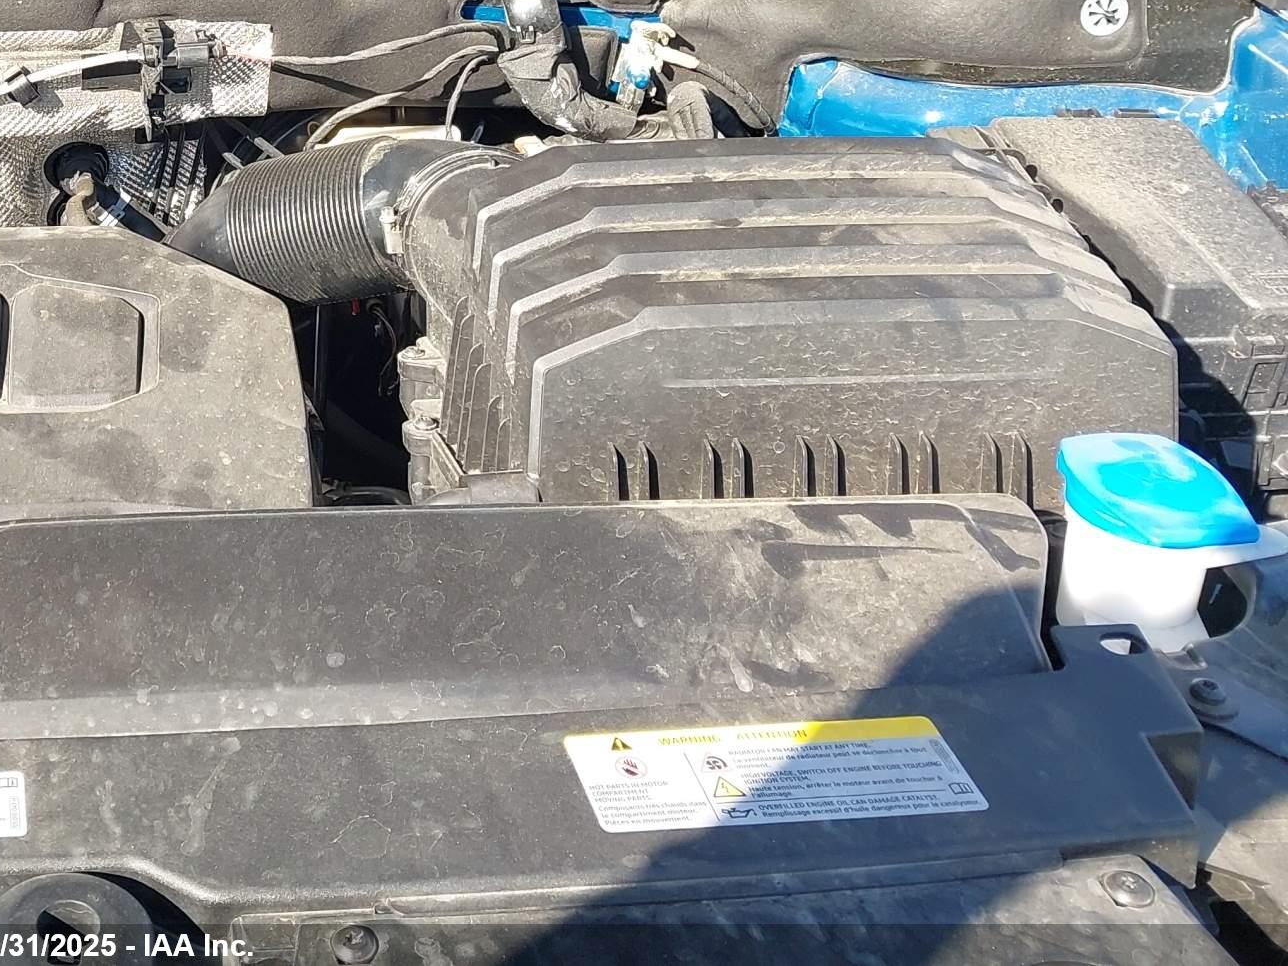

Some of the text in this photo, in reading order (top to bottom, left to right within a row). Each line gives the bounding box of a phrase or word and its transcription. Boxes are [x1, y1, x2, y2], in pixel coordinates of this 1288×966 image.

[797, 752, 833, 760] radiateur
[798, 768, 827, 776] SWITCH
[843, 765, 872, 773] ENGINE
[872, 763, 902, 771] BEFORE
[902, 761, 942, 770] TOUCHING
[744, 777, 779, 785] IGNITION
[758, 802, 806, 811] OVERFILLED
[806, 800, 836, 808] ENGINE
[851, 798, 869, 806] CAN
[868, 796, 901, 804] DAMAGE
[762, 809, 811, 818] Remplissage
[811, 807, 843, 815] excessif
[871, 803, 911, 812] dangereux
[913, 802, 930, 810] pour
